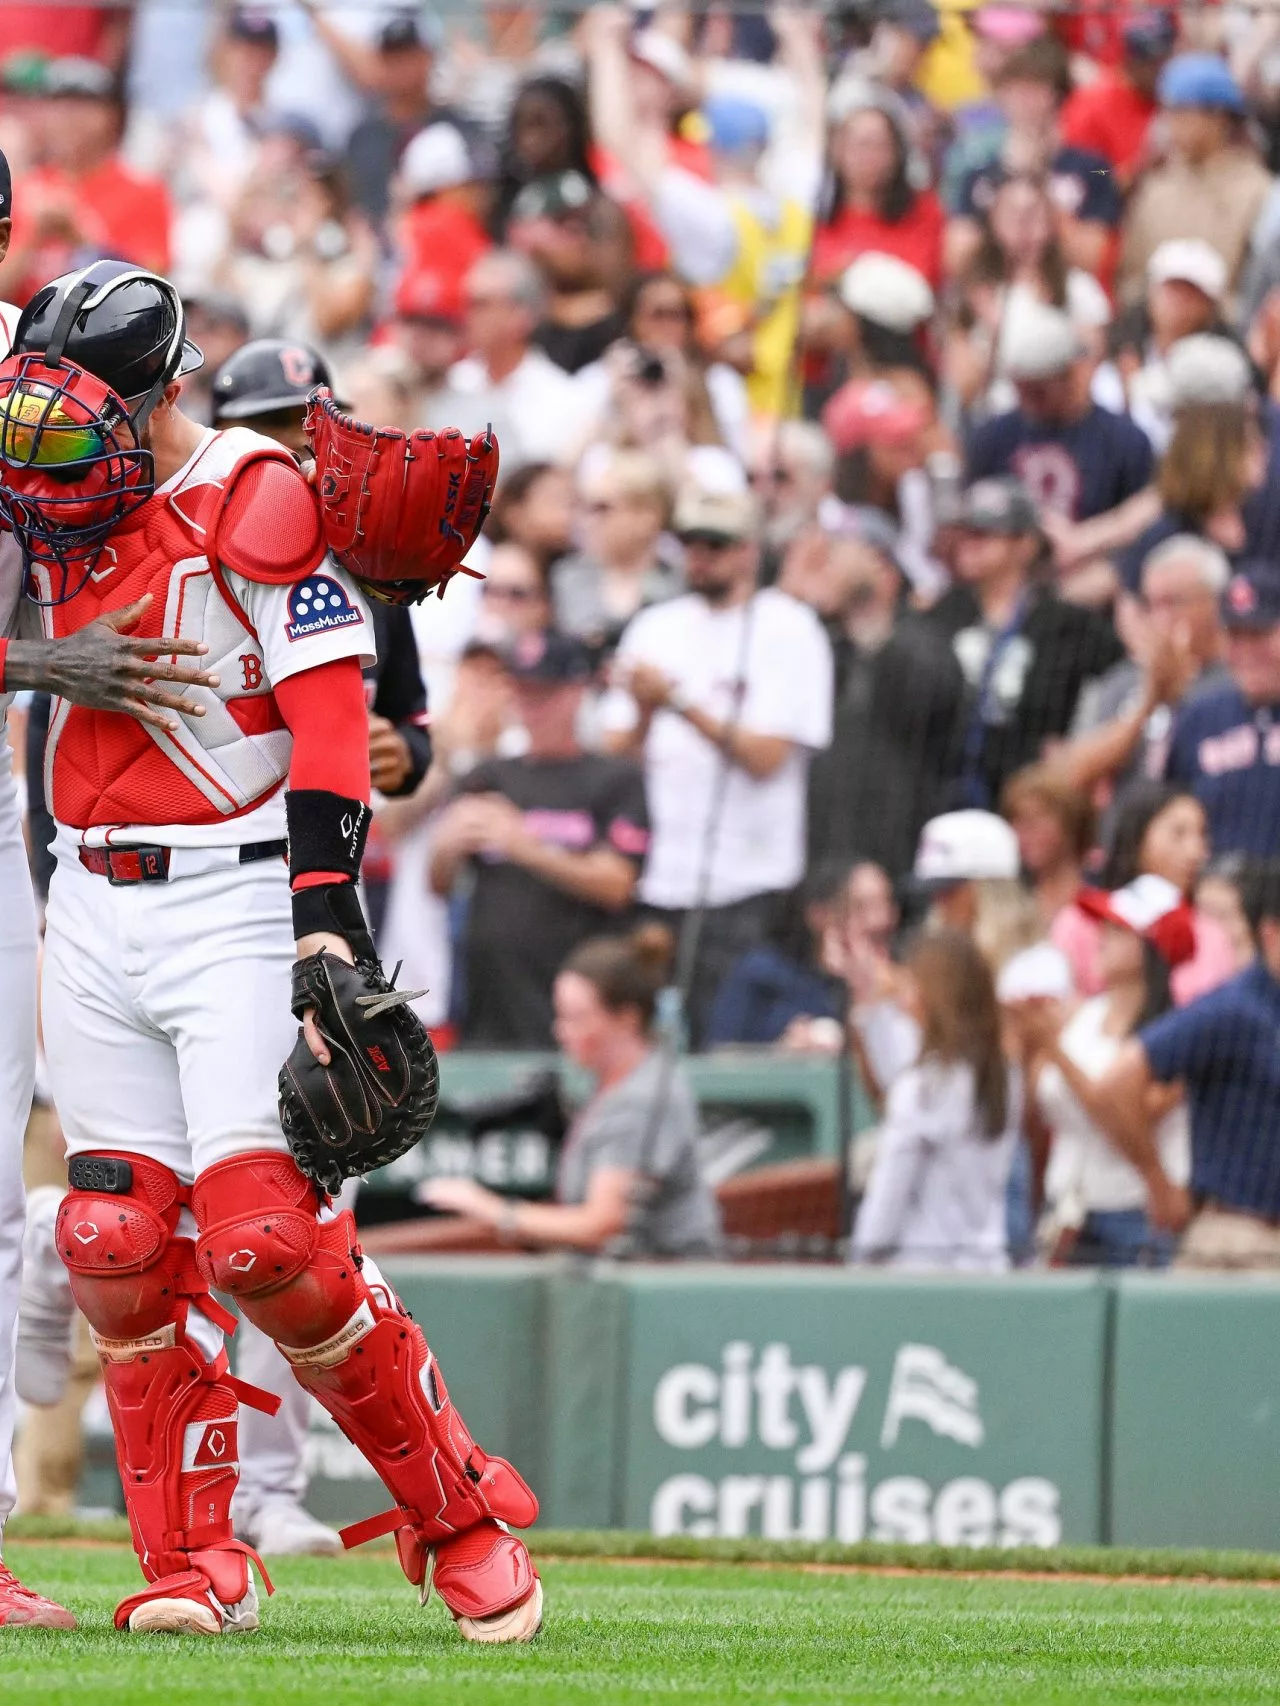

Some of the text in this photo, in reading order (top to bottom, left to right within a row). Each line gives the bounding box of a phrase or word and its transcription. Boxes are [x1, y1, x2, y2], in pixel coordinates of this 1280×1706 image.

[445, 472, 462, 514] SSK
[289, 610, 359, 638] MassMutual
[238, 653, 263, 691] B
[145, 855, 158, 874] 12
[653, 1341, 867, 1473] city
[651, 1452, 1061, 1548] cruises
